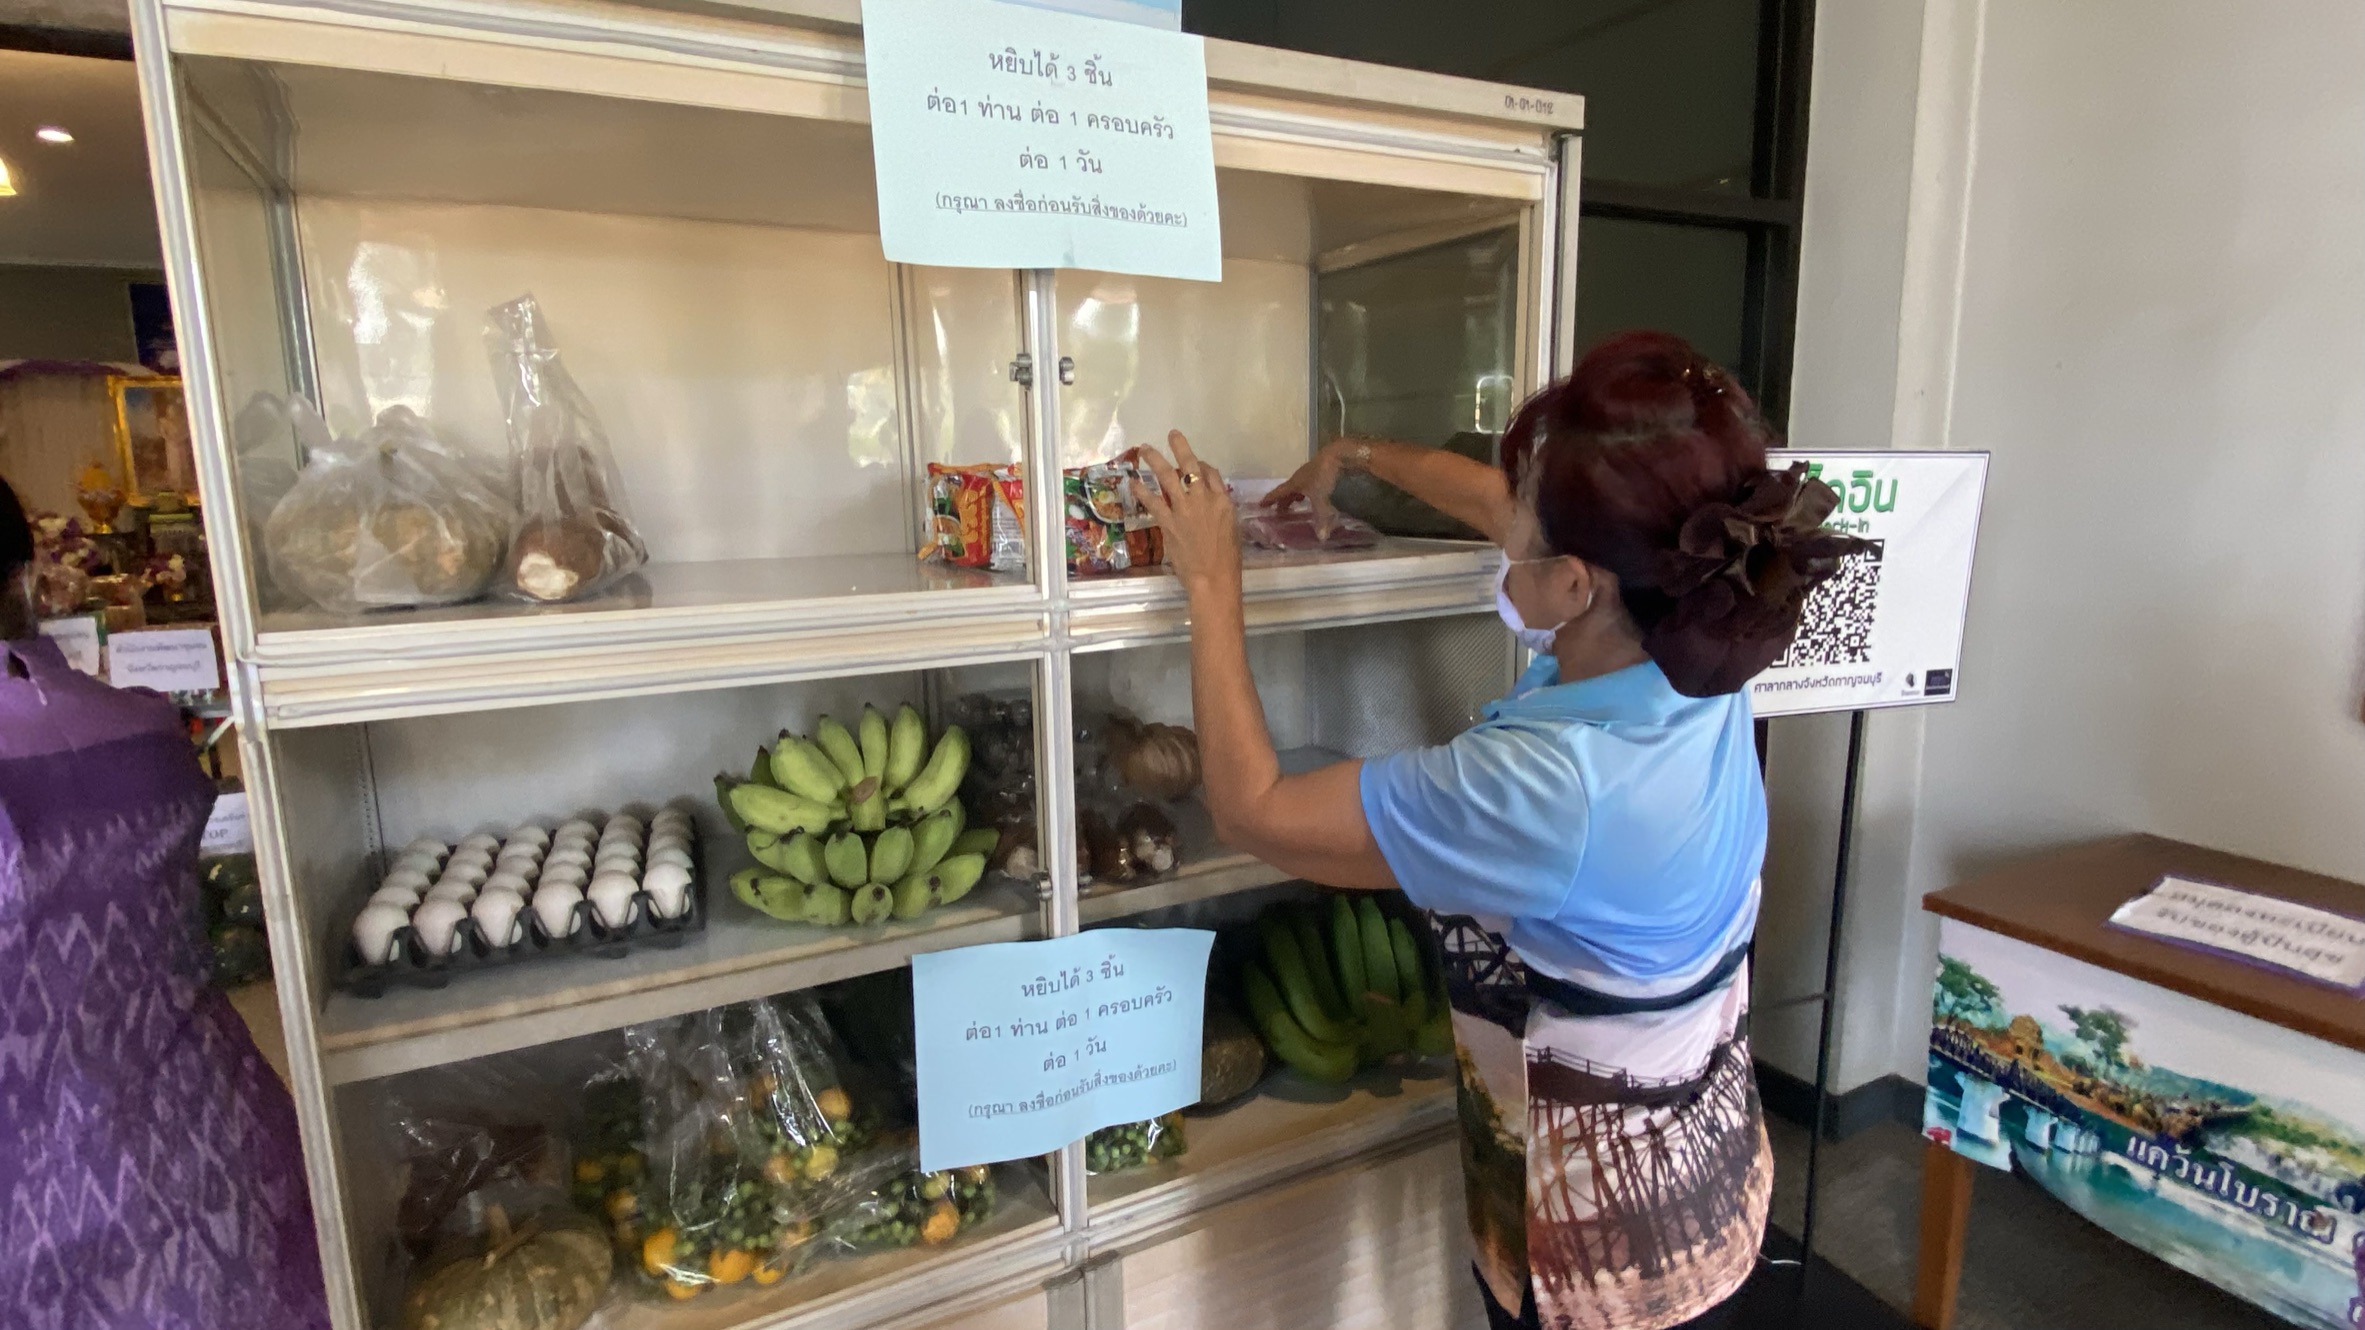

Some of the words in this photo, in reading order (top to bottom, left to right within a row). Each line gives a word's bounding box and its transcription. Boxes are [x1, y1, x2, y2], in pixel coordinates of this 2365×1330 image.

[988, 46, 1059, 80] หยิบได้
[1066, 64, 1077, 82] 3
[1084, 53, 1113, 87] ชิ้น
[978, 94, 1022, 122] ท่าน
[1030, 100, 1060, 125] ต่อ
[1070, 111, 1078, 127] 1
[1087, 113, 1175, 140] ครอบครัว
[1019, 146, 1049, 170] ต่อ
[1059, 154, 1067, 171] 1
[1076, 149, 1103, 174] วัน
[935, 192, 988, 215] (กรุณา
[1754, 671, 1883, 693] ศาลากลางจังหวัดกาญจนบุรี
[1021, 967, 1081, 997] หยิบได้
[1085, 969, 1094, 983] 3
[1100, 954, 1124, 979] ชิ้น
[1010, 1017, 1048, 1037] ท่าน
[1055, 1010, 1078, 1031] ต่อ
[1085, 1007, 1091, 1020] 1
[1098, 985, 1173, 1017] ครอบครัว
[1043, 1052, 1066, 1072] ต่อ
[1074, 1049, 1080, 1062] 1
[1086, 1035, 1107, 1056] วัน
[968, 1102, 1014, 1119] (กรุณา
